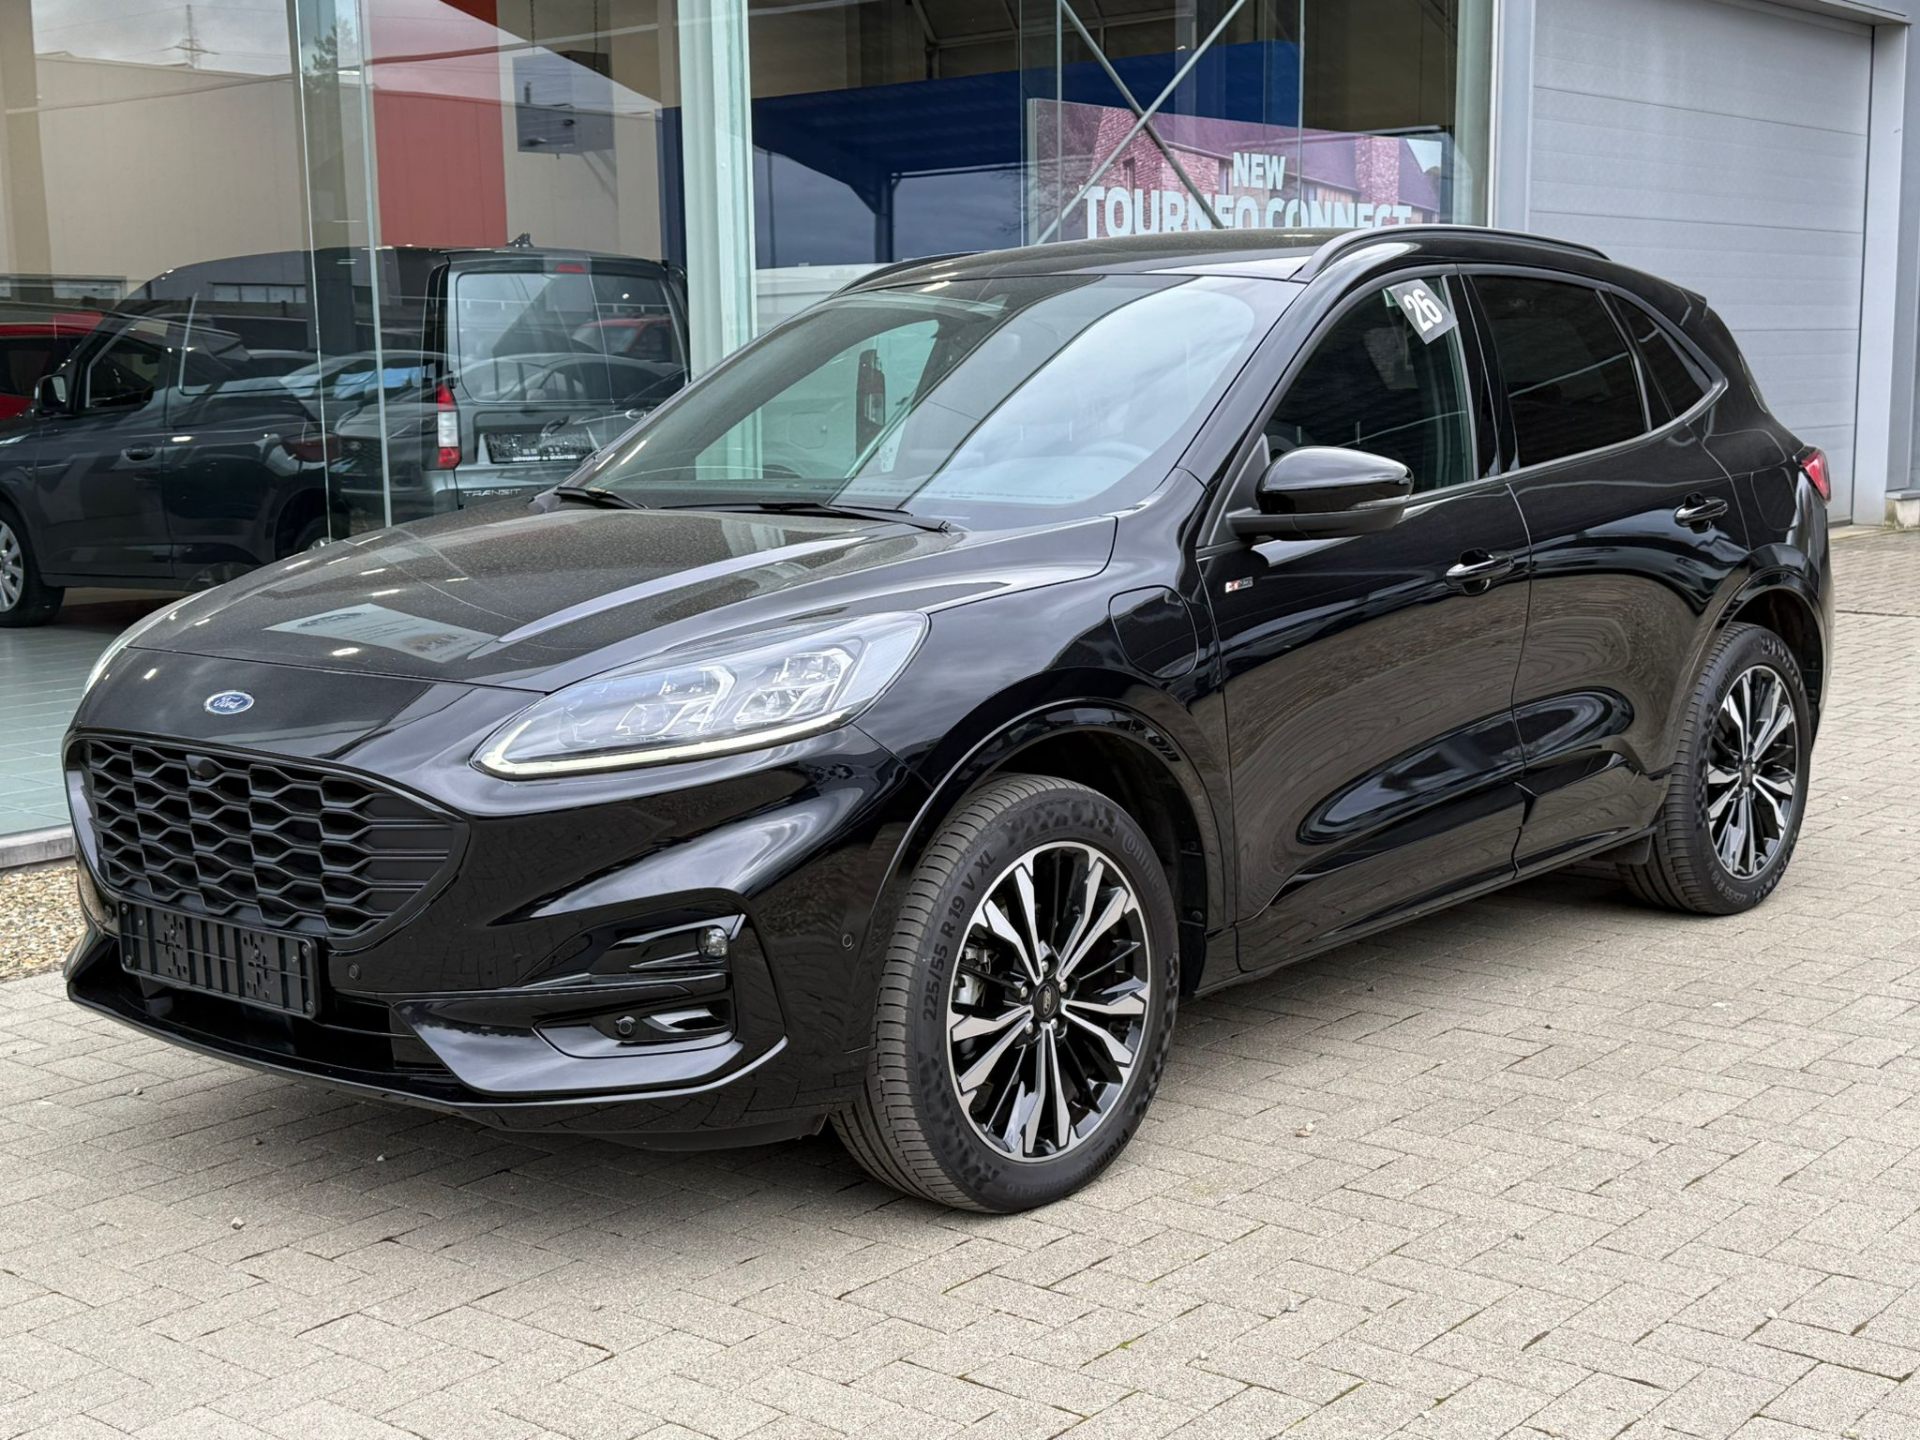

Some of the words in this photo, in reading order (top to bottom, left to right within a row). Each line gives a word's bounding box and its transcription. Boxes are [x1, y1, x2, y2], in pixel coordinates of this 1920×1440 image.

[1233, 152, 1286, 190] NEW
[1079, 185, 1259, 239] TOURNEO
[1403, 288, 1443, 332] 26
[462, 488, 521, 497] TRANSIT
[923, 942, 948, 1022] 225/55
[940, 922, 956, 938] R
[948, 895, 966, 920] 19
[961, 873, 976, 892] V
[974, 850, 996, 876] XL
